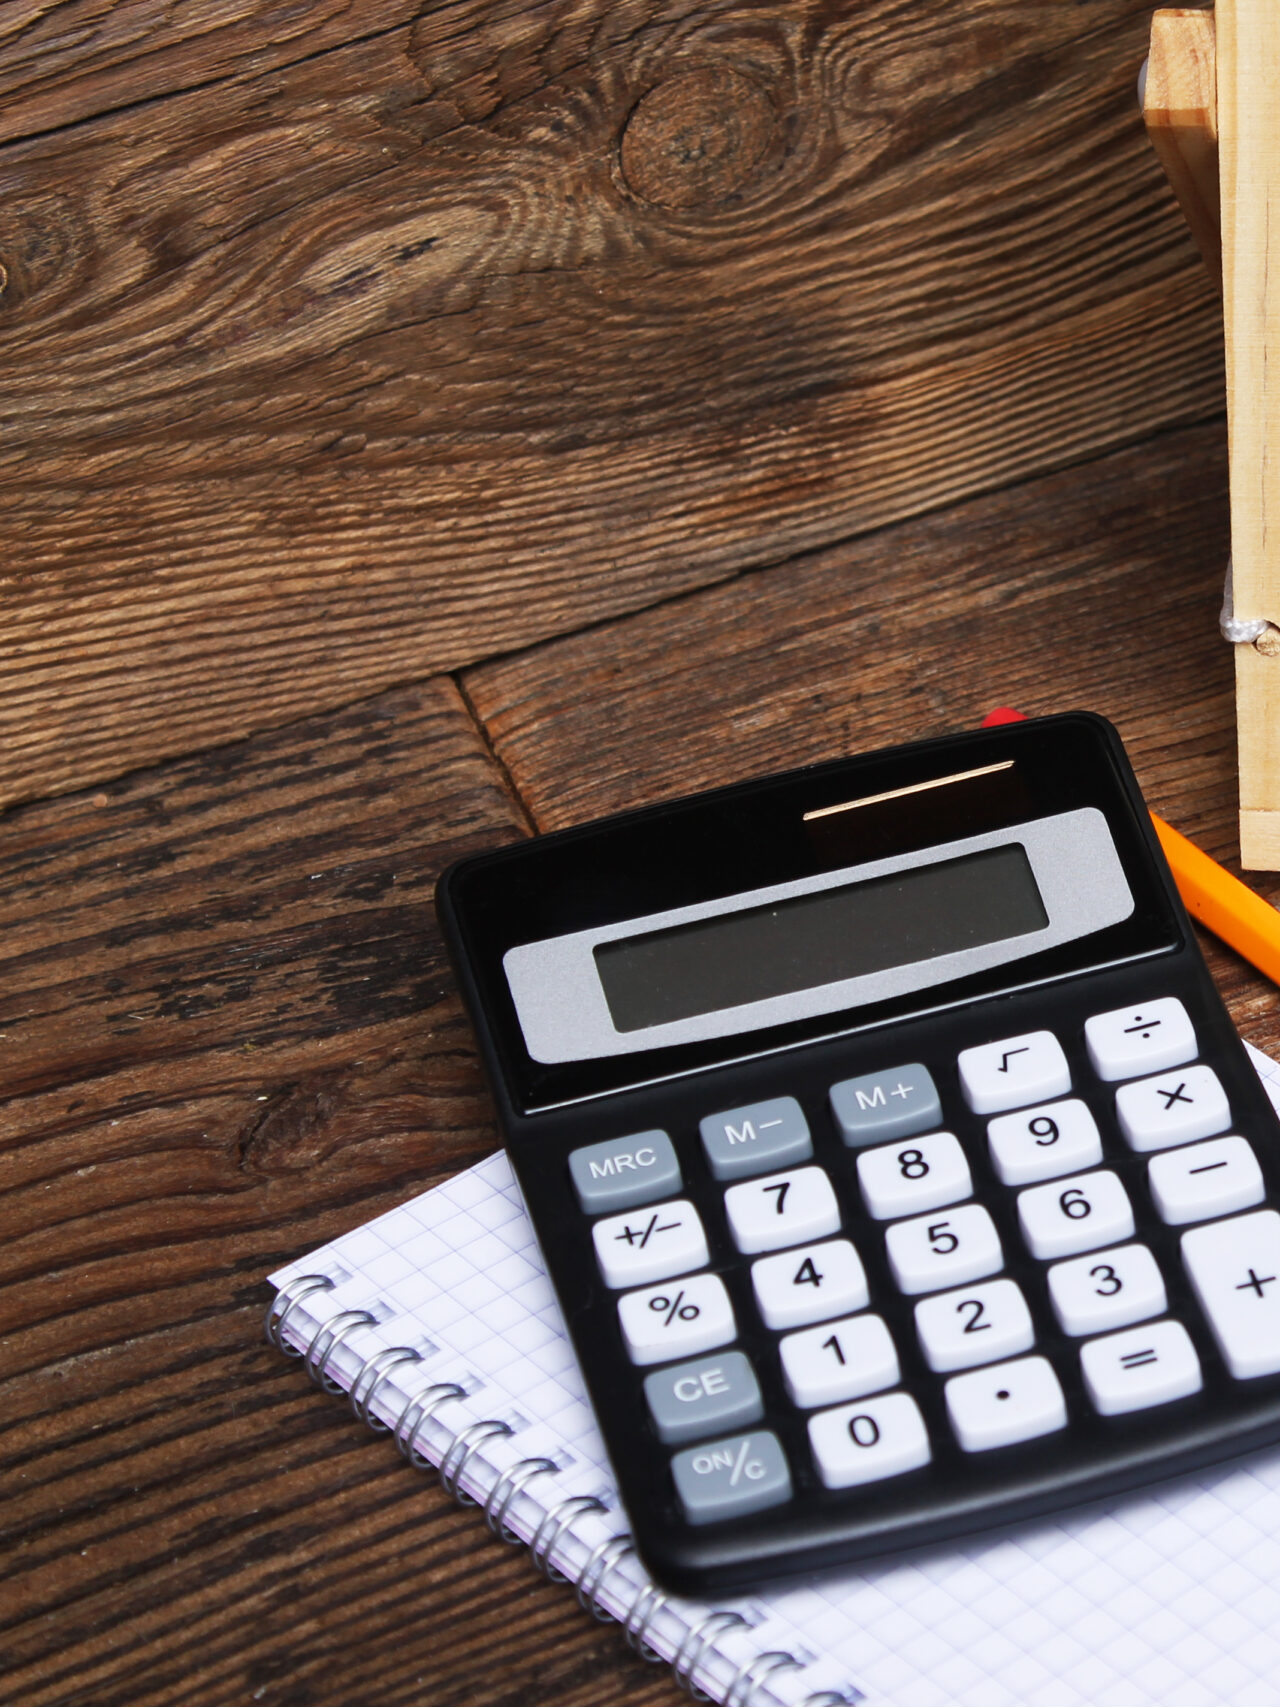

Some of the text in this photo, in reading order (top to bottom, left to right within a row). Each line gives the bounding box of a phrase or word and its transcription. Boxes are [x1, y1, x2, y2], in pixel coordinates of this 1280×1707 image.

[1028, 1117, 1059, 1146] 9
[589, 1148, 656, 1178] MRC
[898, 1150, 929, 1179] 8
[763, 1182, 790, 1214] 7
[1060, 1189, 1091, 1219] 6
[928, 1222, 958, 1254] 5
[794, 1258, 823, 1287] 4
[1090, 1265, 1122, 1296] 3
[649, 1291, 700, 1325] %
[957, 1301, 991, 1333] 2
[823, 1336, 845, 1365] 1
[674, 1369, 729, 1401] CE
[848, 1415, 880, 1447] 0
